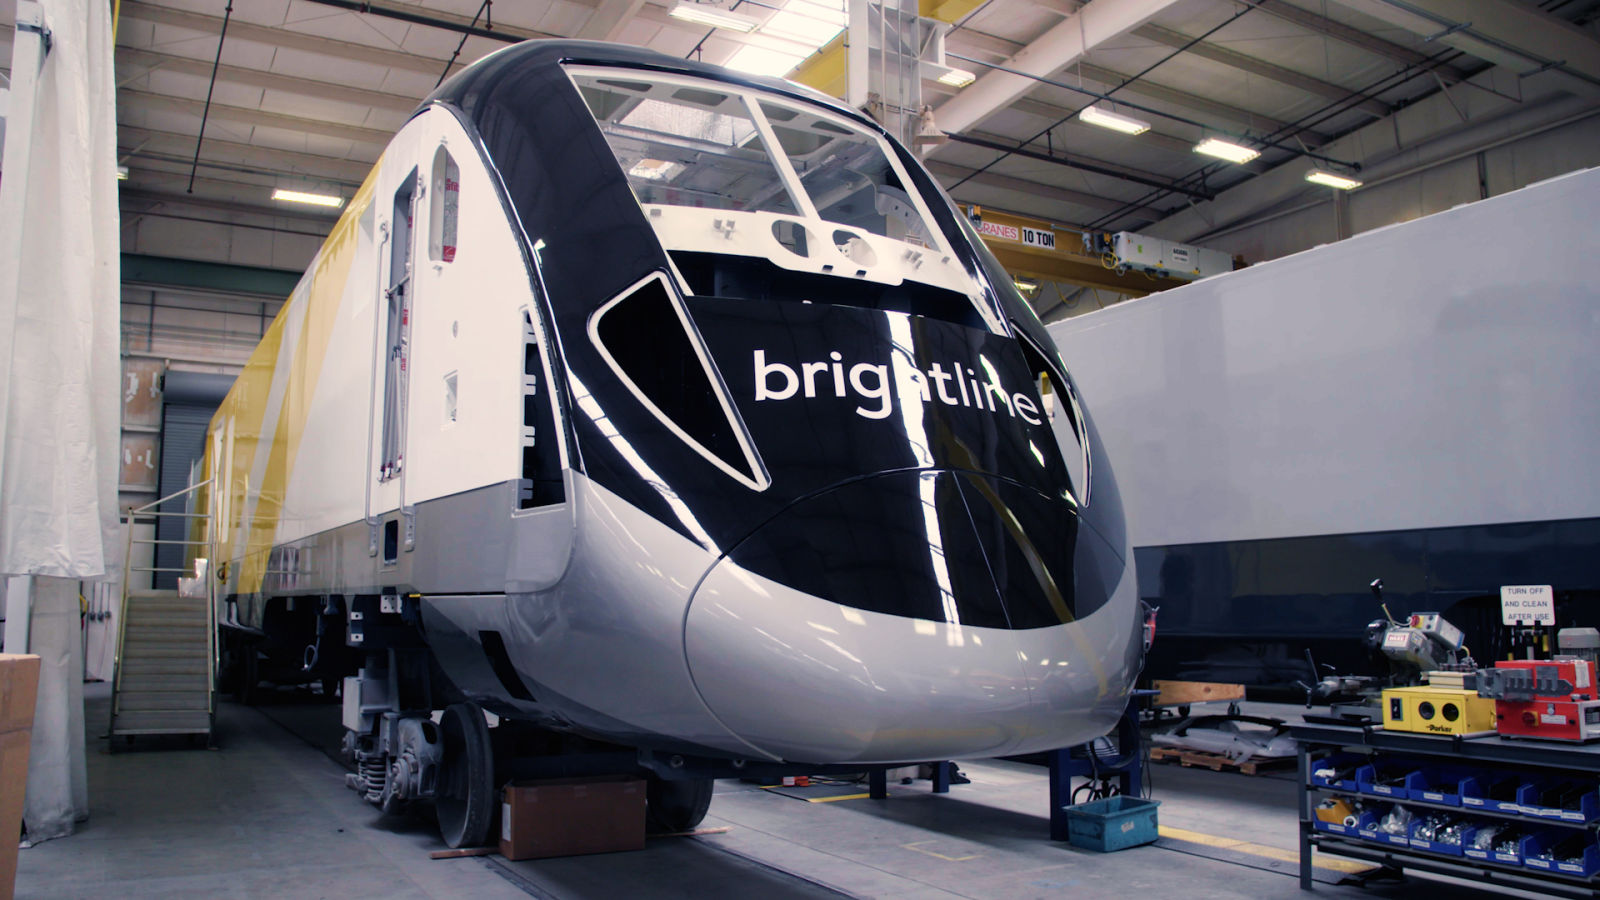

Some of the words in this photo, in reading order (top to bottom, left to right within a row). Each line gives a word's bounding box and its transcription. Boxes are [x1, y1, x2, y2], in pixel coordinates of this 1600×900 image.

[1023, 229, 1034, 243] 10
[1036, 231, 1055, 247] TON
[753, 349, 1042, 426] brightline
